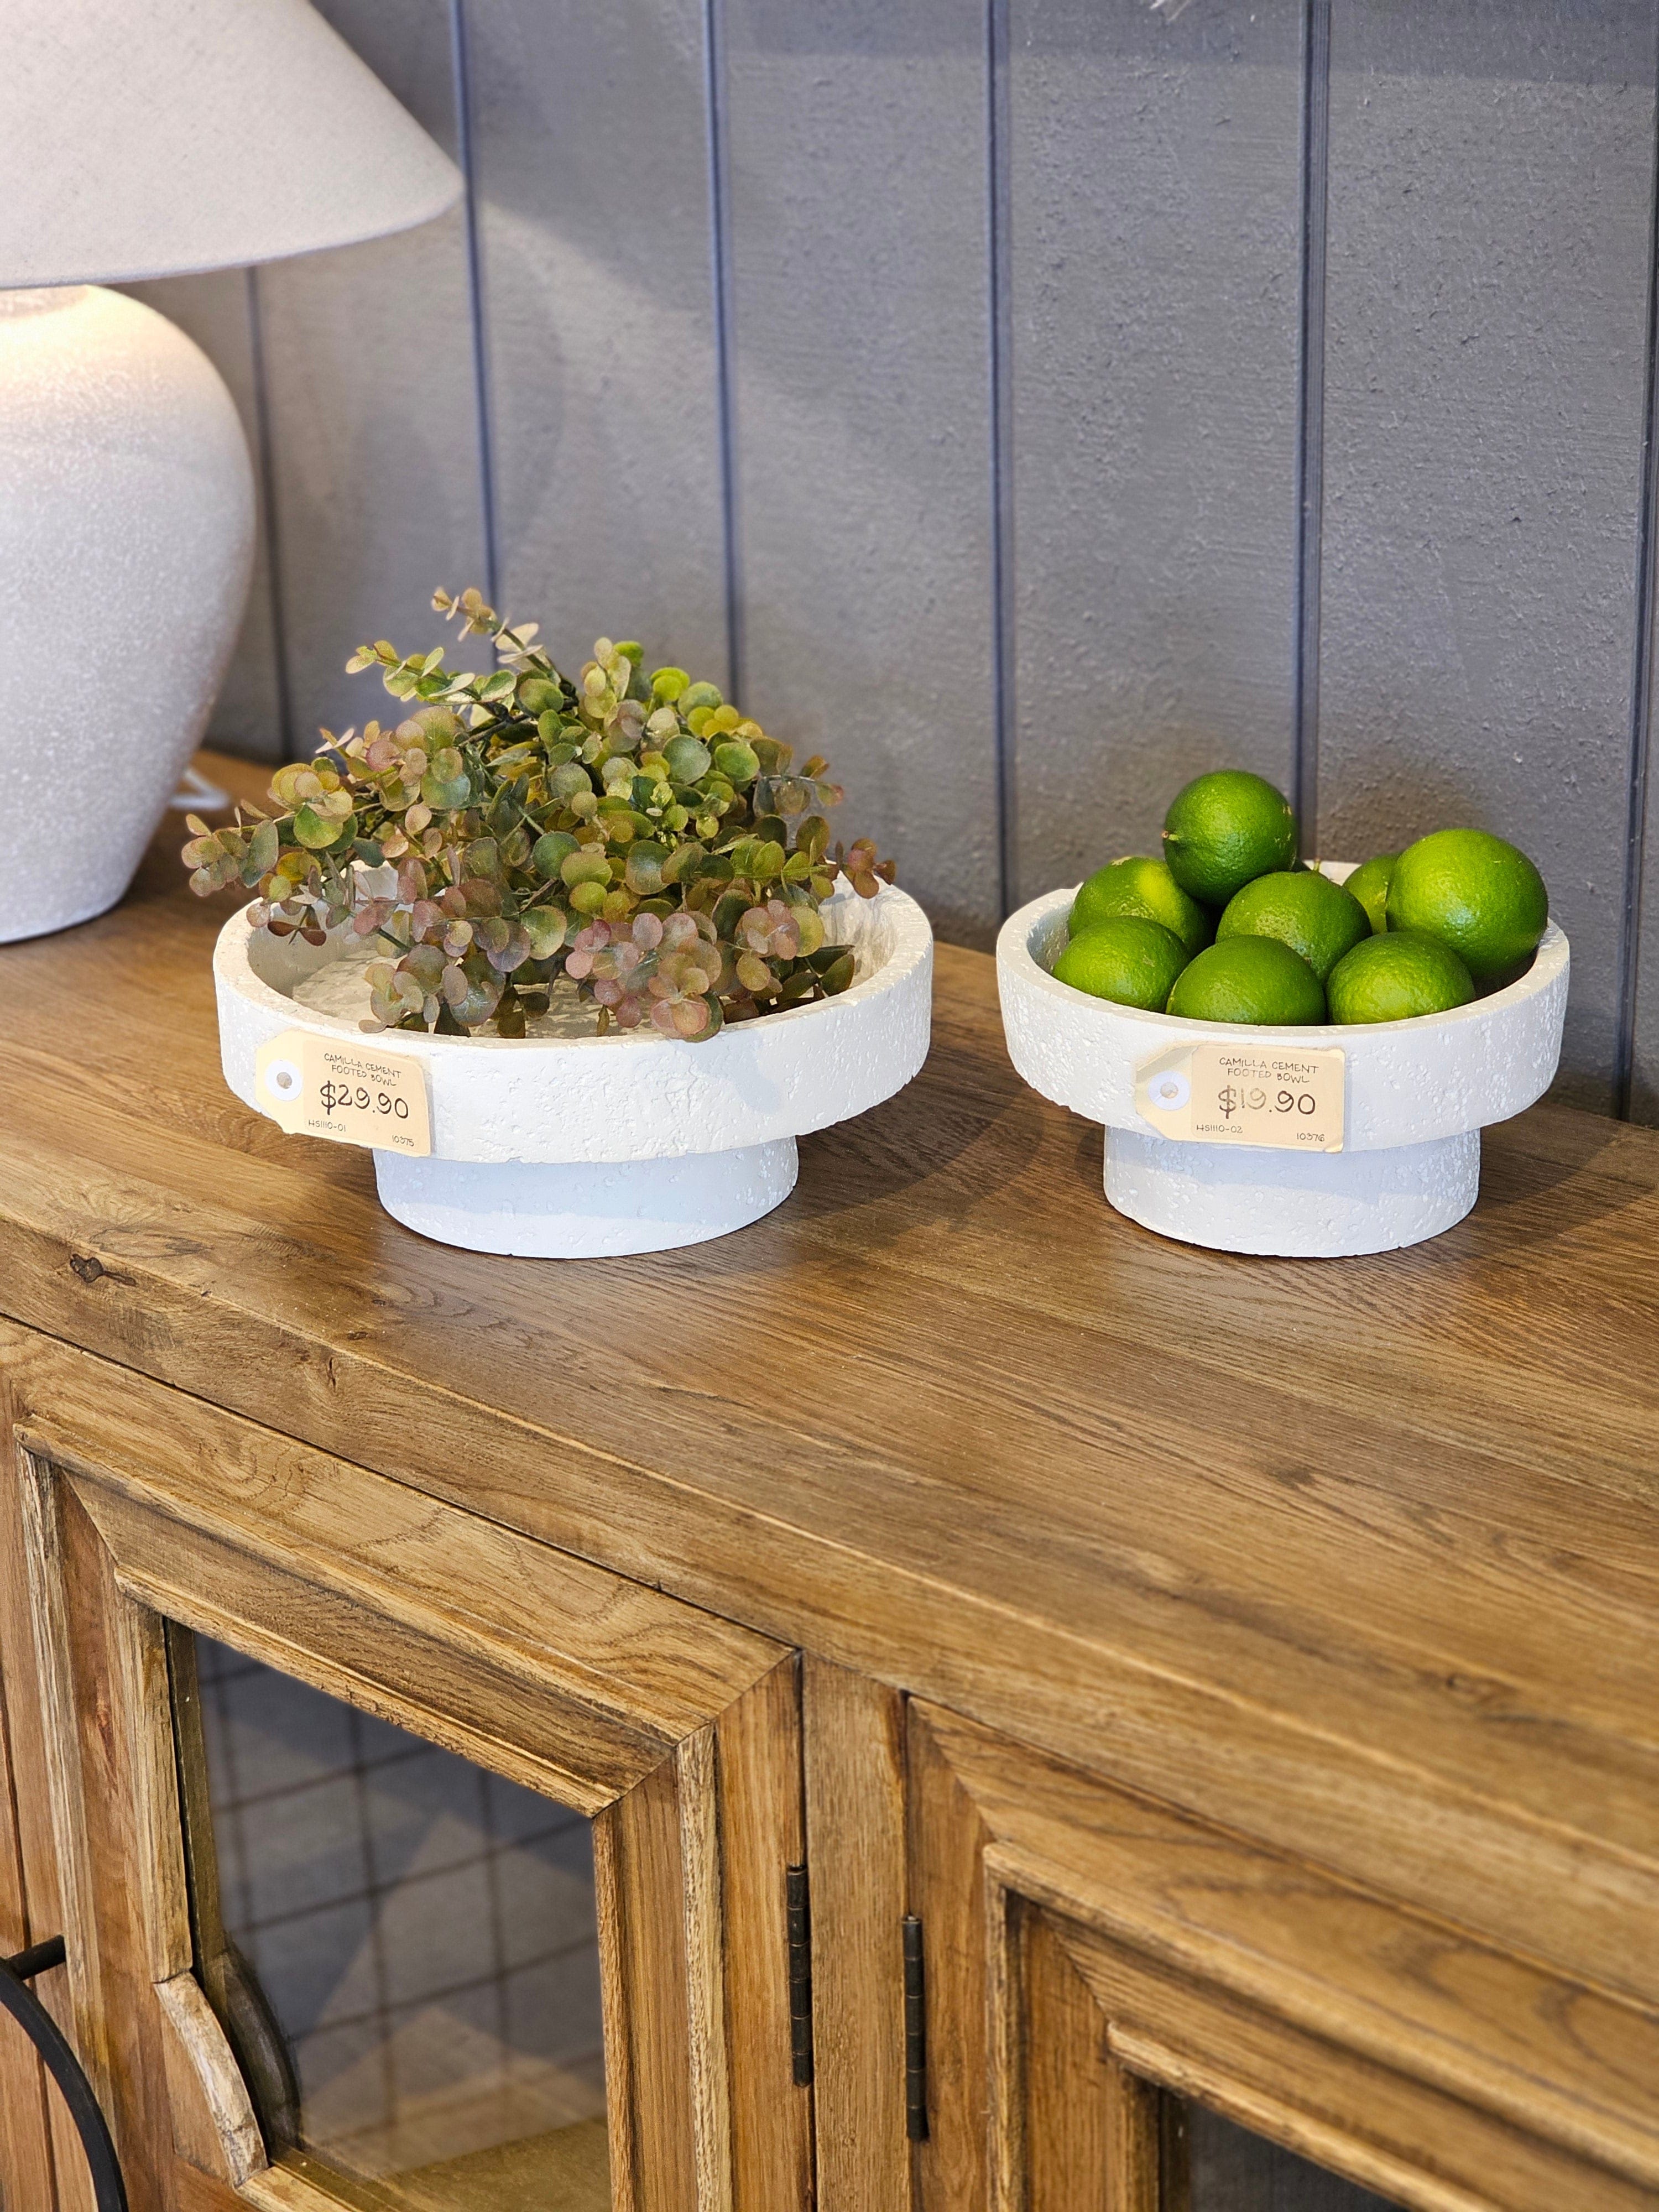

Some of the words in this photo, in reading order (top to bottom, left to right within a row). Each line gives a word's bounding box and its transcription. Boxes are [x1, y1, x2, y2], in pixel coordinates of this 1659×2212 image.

[324, 1053, 362, 1068] CAMILLA
[366, 1063, 401, 1078] CEMENT
[1219, 1057, 1267, 1069] CAMILLA
[1272, 1061, 1319, 1074] CEMENT
[332, 1065, 367, 1078] FOOTED
[371, 1074, 397, 1086] BOWL
[1228, 1067, 1272, 1078] FOOTED
[1277, 1072, 1310, 1084] BOWL
[320, 1080, 409, 1119] $29.90
[1218, 1084, 1316, 1119] $19.90
[308, 1119, 346, 1132] HS1110-01
[1196, 1124, 1243, 1134] HS1110-02
[1296, 1132, 1325, 1142] 10376
